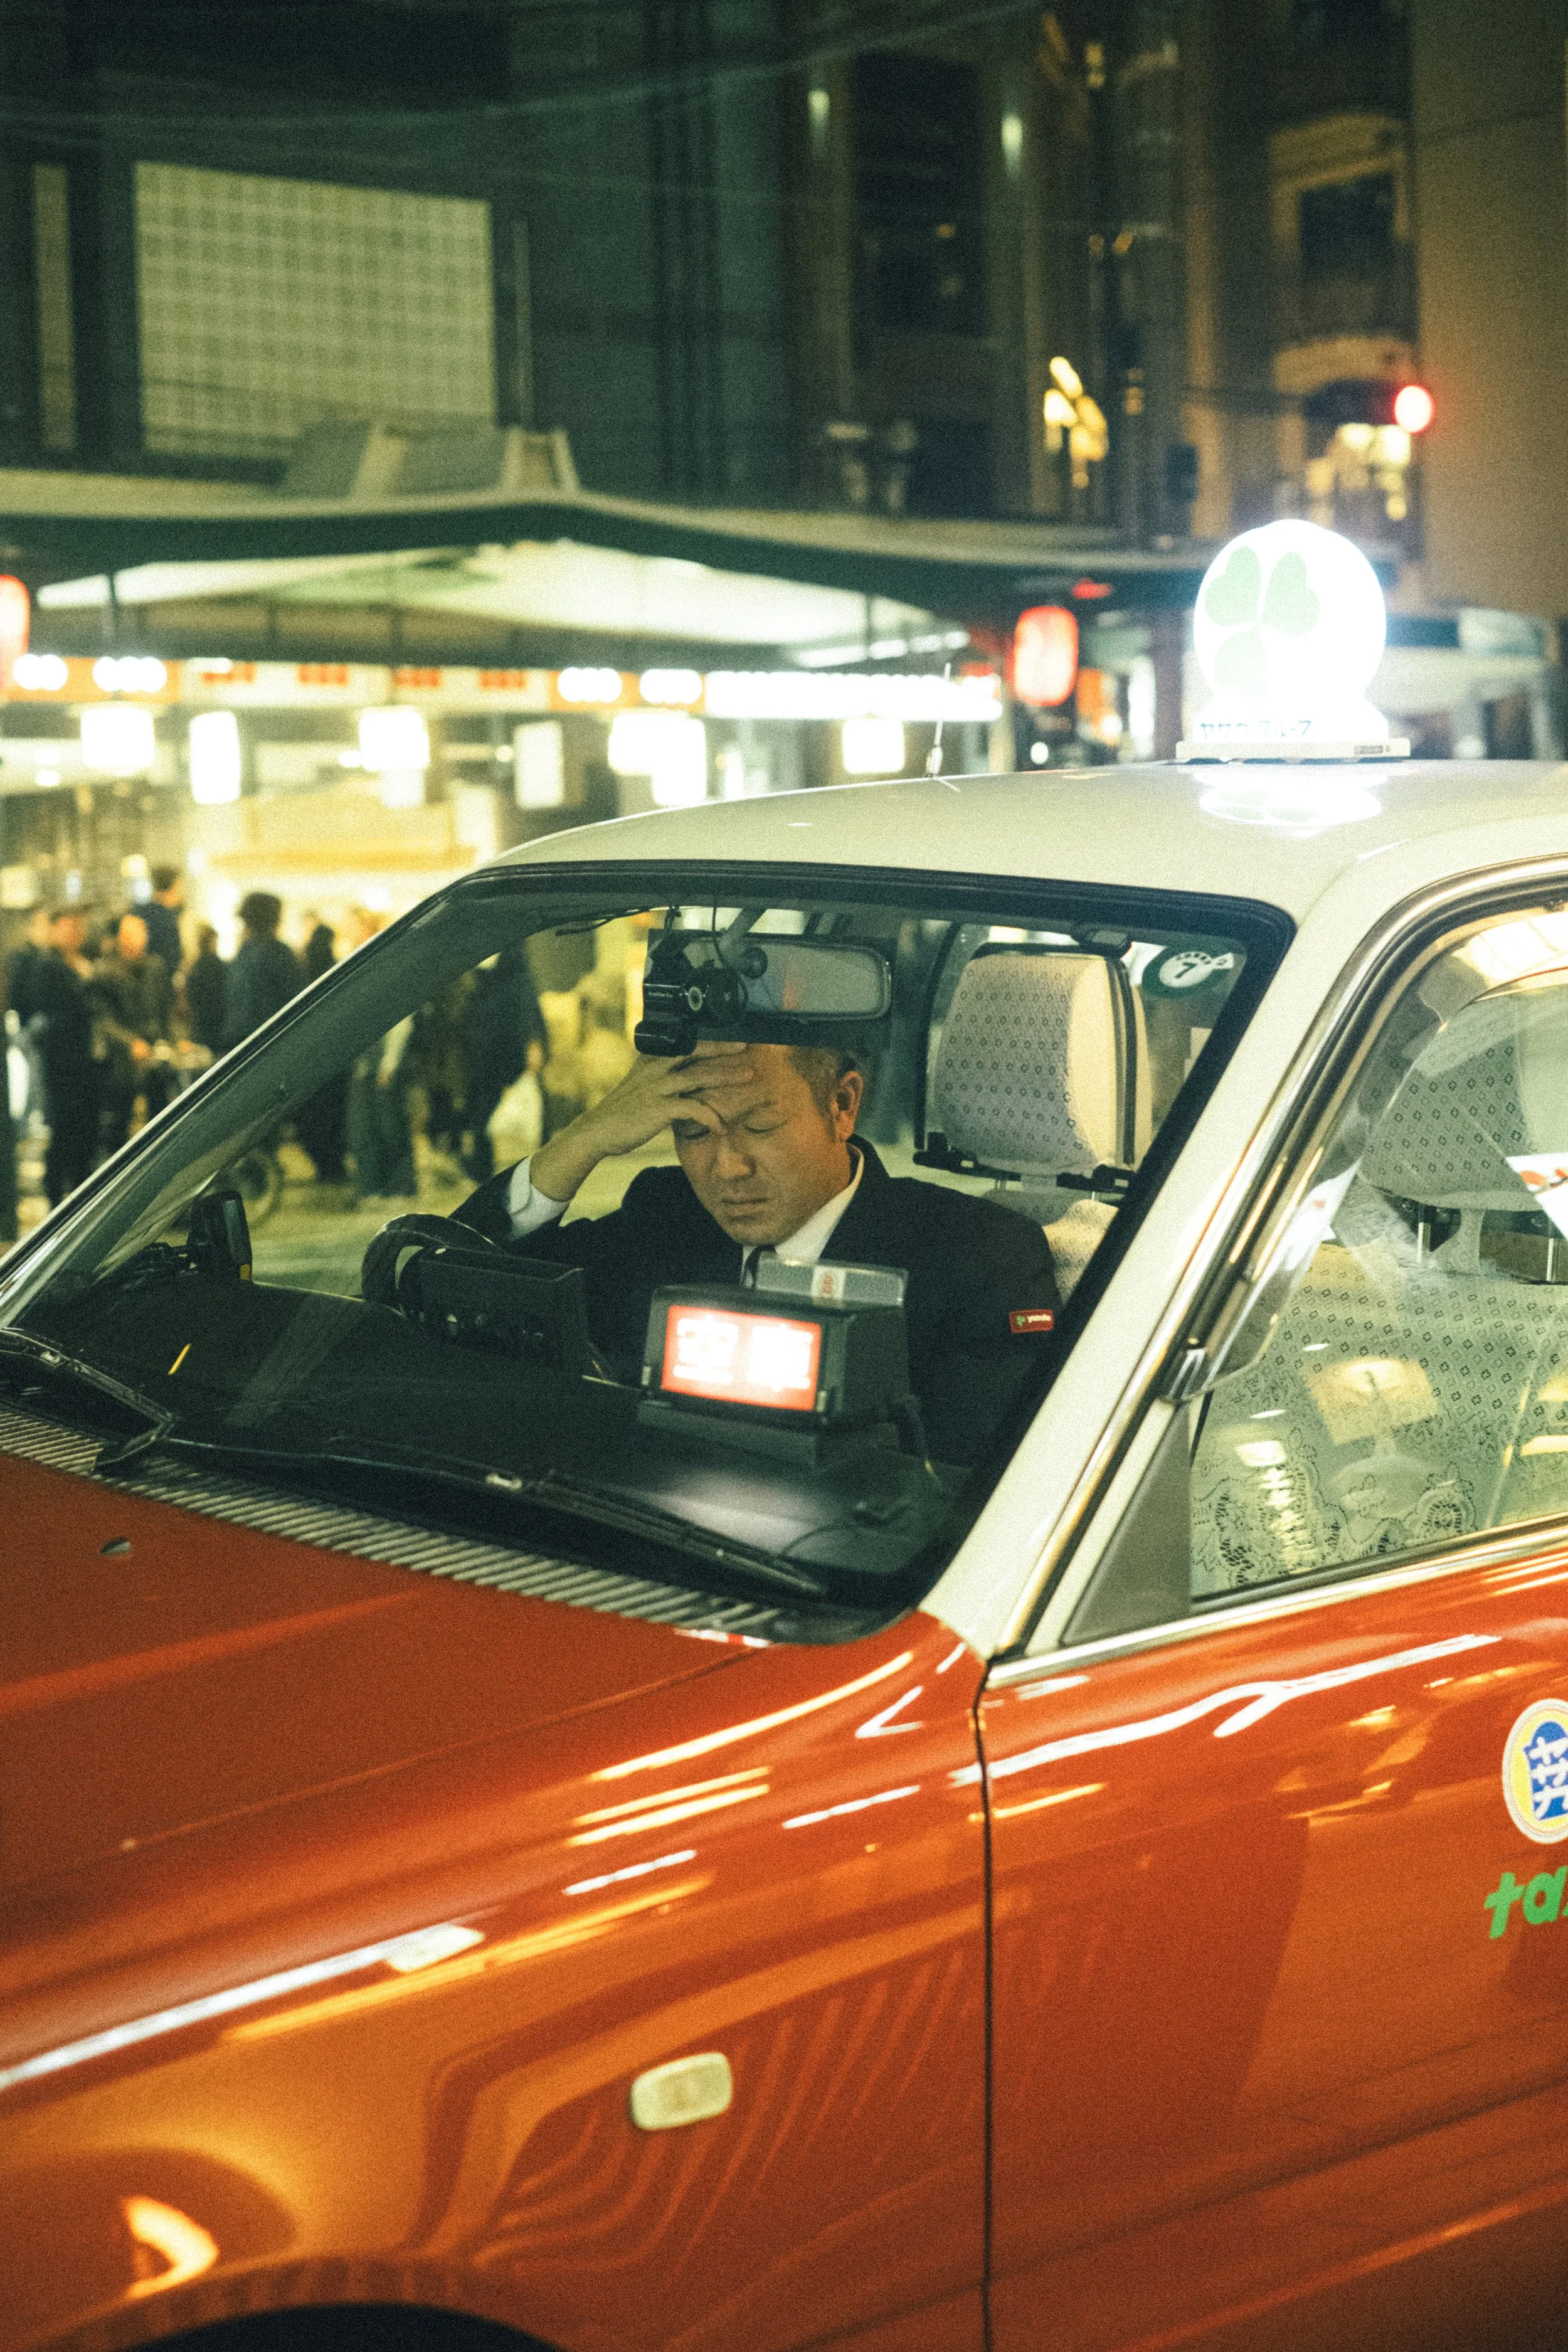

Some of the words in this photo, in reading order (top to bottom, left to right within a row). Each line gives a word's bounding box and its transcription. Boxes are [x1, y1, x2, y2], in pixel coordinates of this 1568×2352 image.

[1175, 961, 1197, 978] 7
[1529, 1735, 1568, 1820] ヤサカ
[1483, 1865, 1568, 1939] ta
